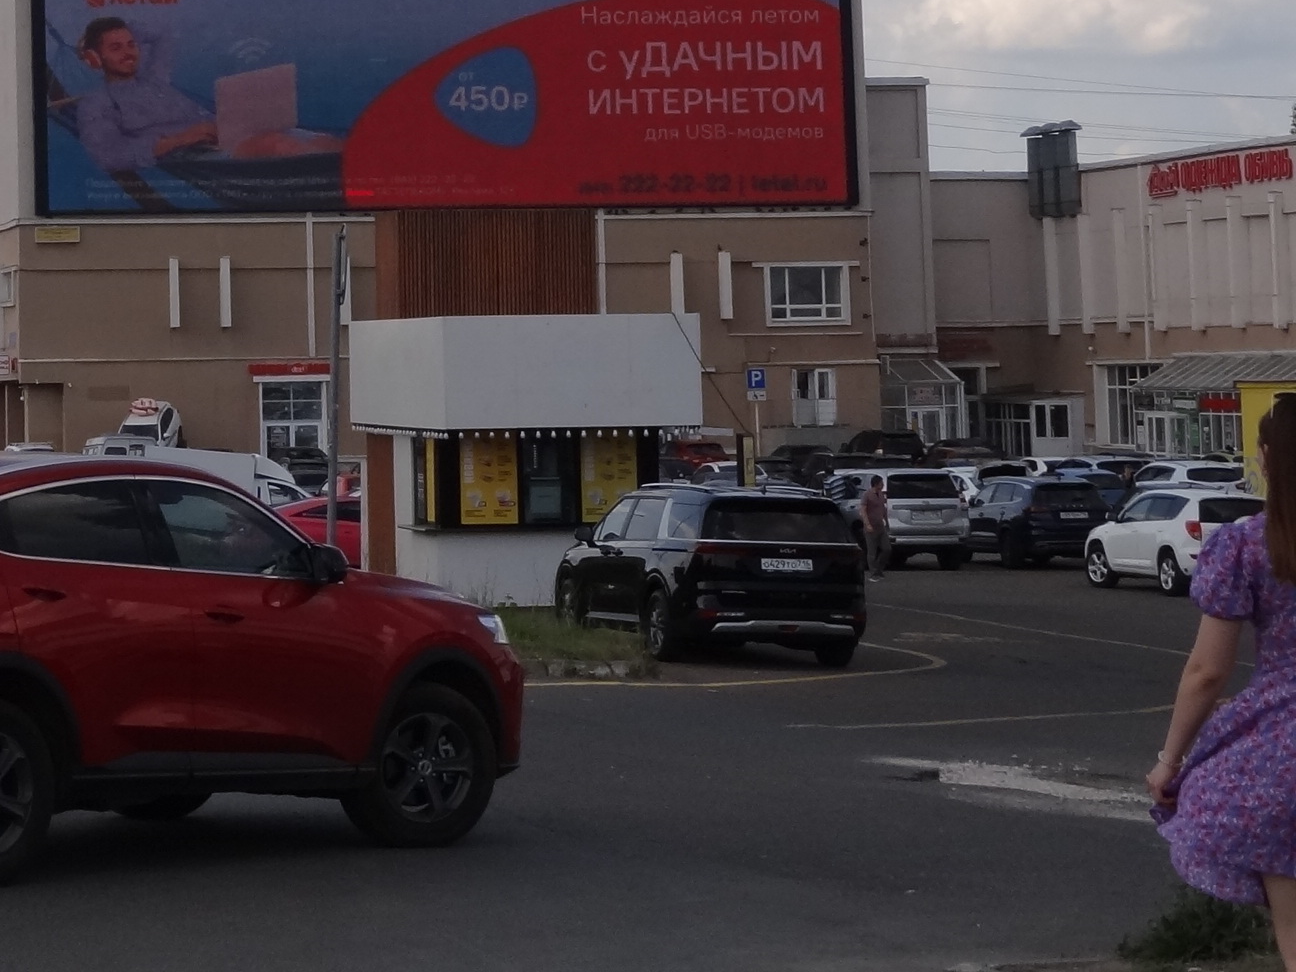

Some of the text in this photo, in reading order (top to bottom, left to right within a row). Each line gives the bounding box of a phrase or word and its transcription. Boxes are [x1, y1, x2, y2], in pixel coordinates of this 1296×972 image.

[581, 5, 820, 27] Наслаждайся летом
[587, 40, 823, 80] с уДАЧНЫМ
[588, 87, 824, 115] ИНТЕРНЕТОМ
[644, 123, 824, 142] для USB-модемов
[1181, 154, 1242, 193] ОДЕЖДА
[1244, 148, 1293, 183] ОБУВЬ
[751, 370, 762, 387] P
